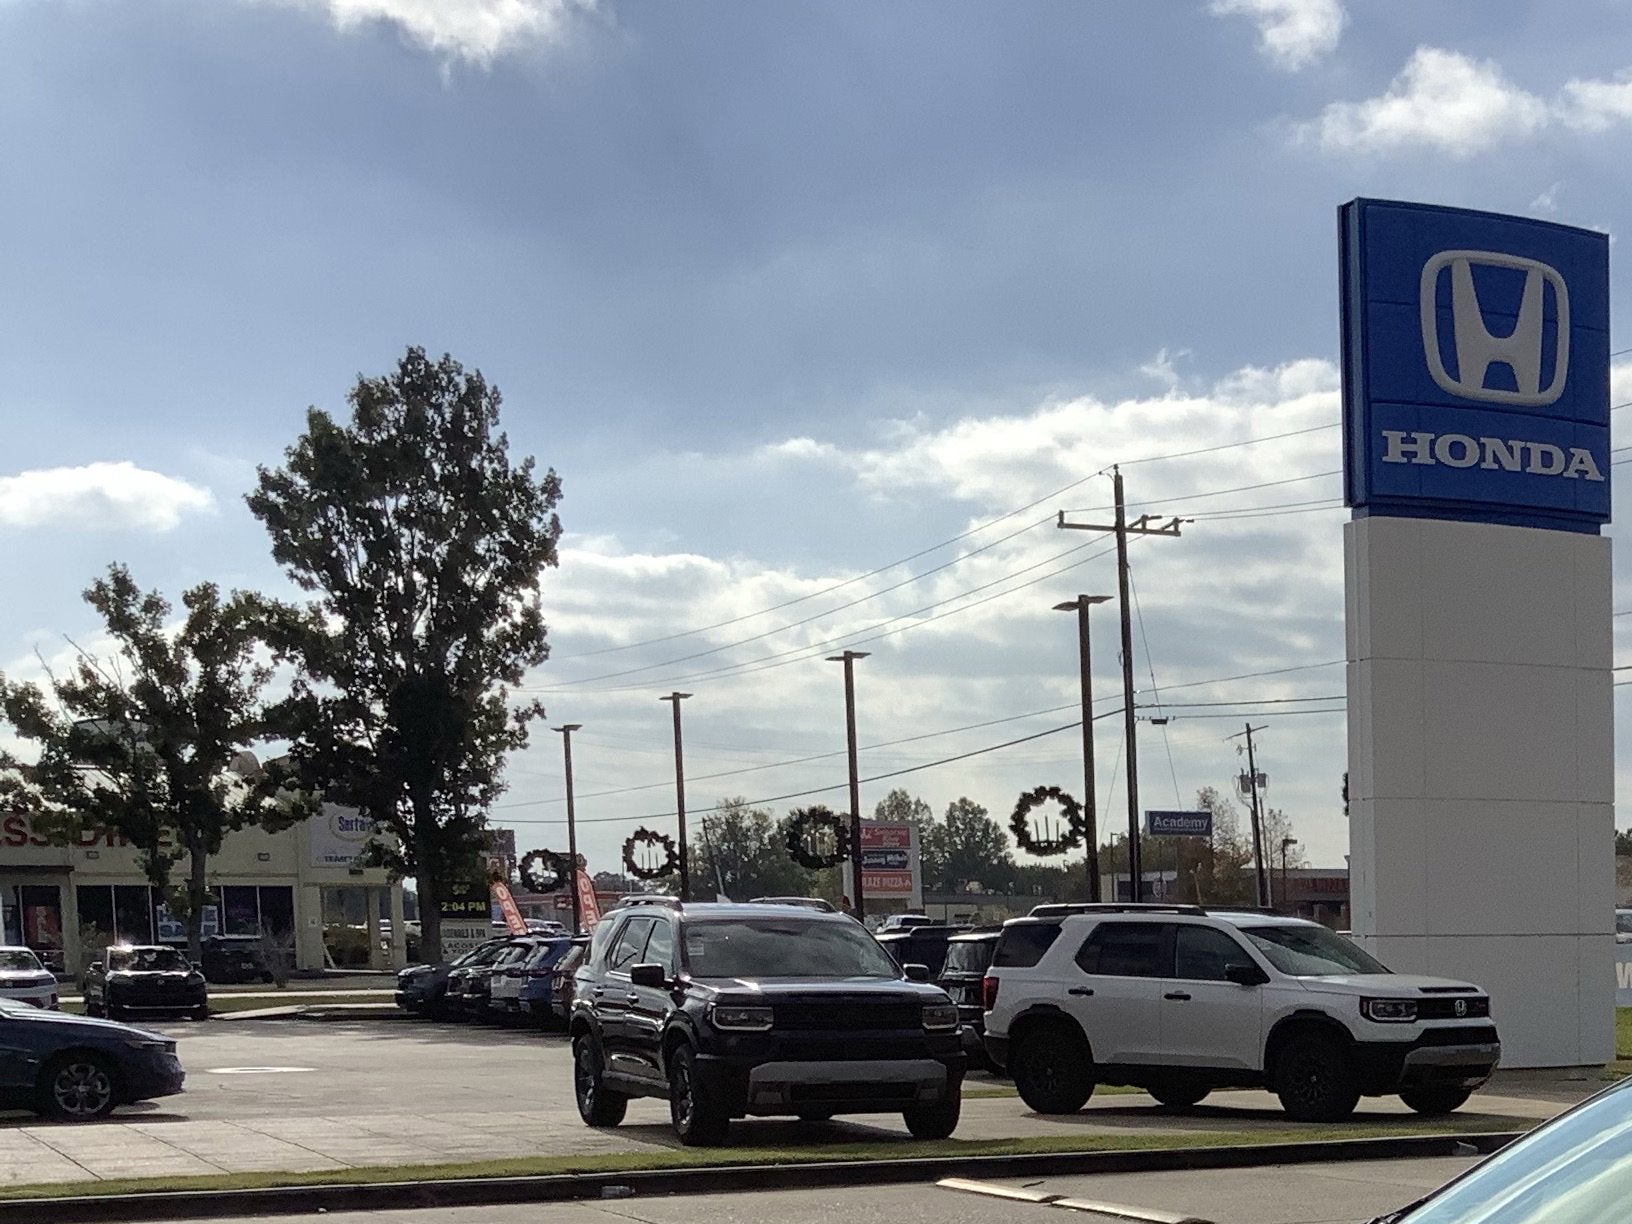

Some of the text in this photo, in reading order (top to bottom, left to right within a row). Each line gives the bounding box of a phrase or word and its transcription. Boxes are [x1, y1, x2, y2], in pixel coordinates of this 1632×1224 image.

[1382, 430, 1605, 482] HONDA
[1154, 816, 1208, 830] Academy
[441, 901, 486, 912] 2:04 PM
[580, 878, 598, 932] OPE
